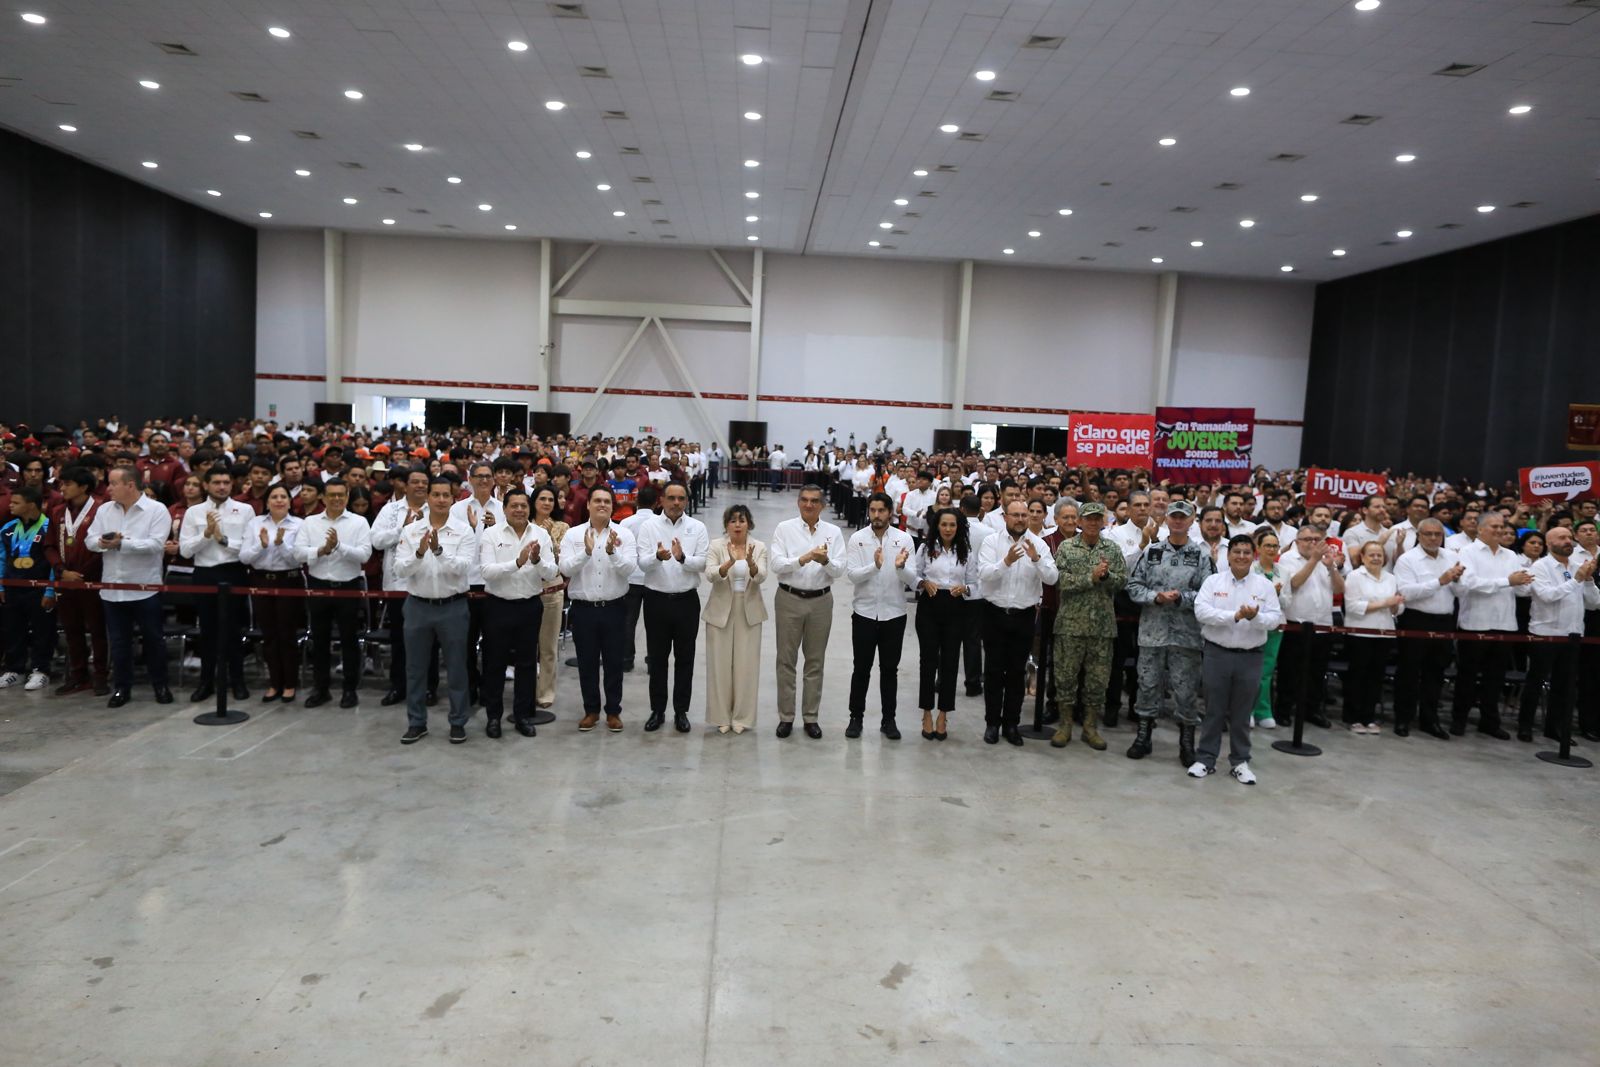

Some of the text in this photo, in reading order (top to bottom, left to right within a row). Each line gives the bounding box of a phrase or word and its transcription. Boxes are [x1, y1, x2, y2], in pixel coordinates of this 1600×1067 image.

[1073, 423, 1150, 443] ¡Claro que
[1190, 421, 1249, 432] Tamaulipas
[1076, 440, 1150, 457] se puede!
[1185, 450, 1218, 459] somos
[1314, 472, 1378, 495] injuve
